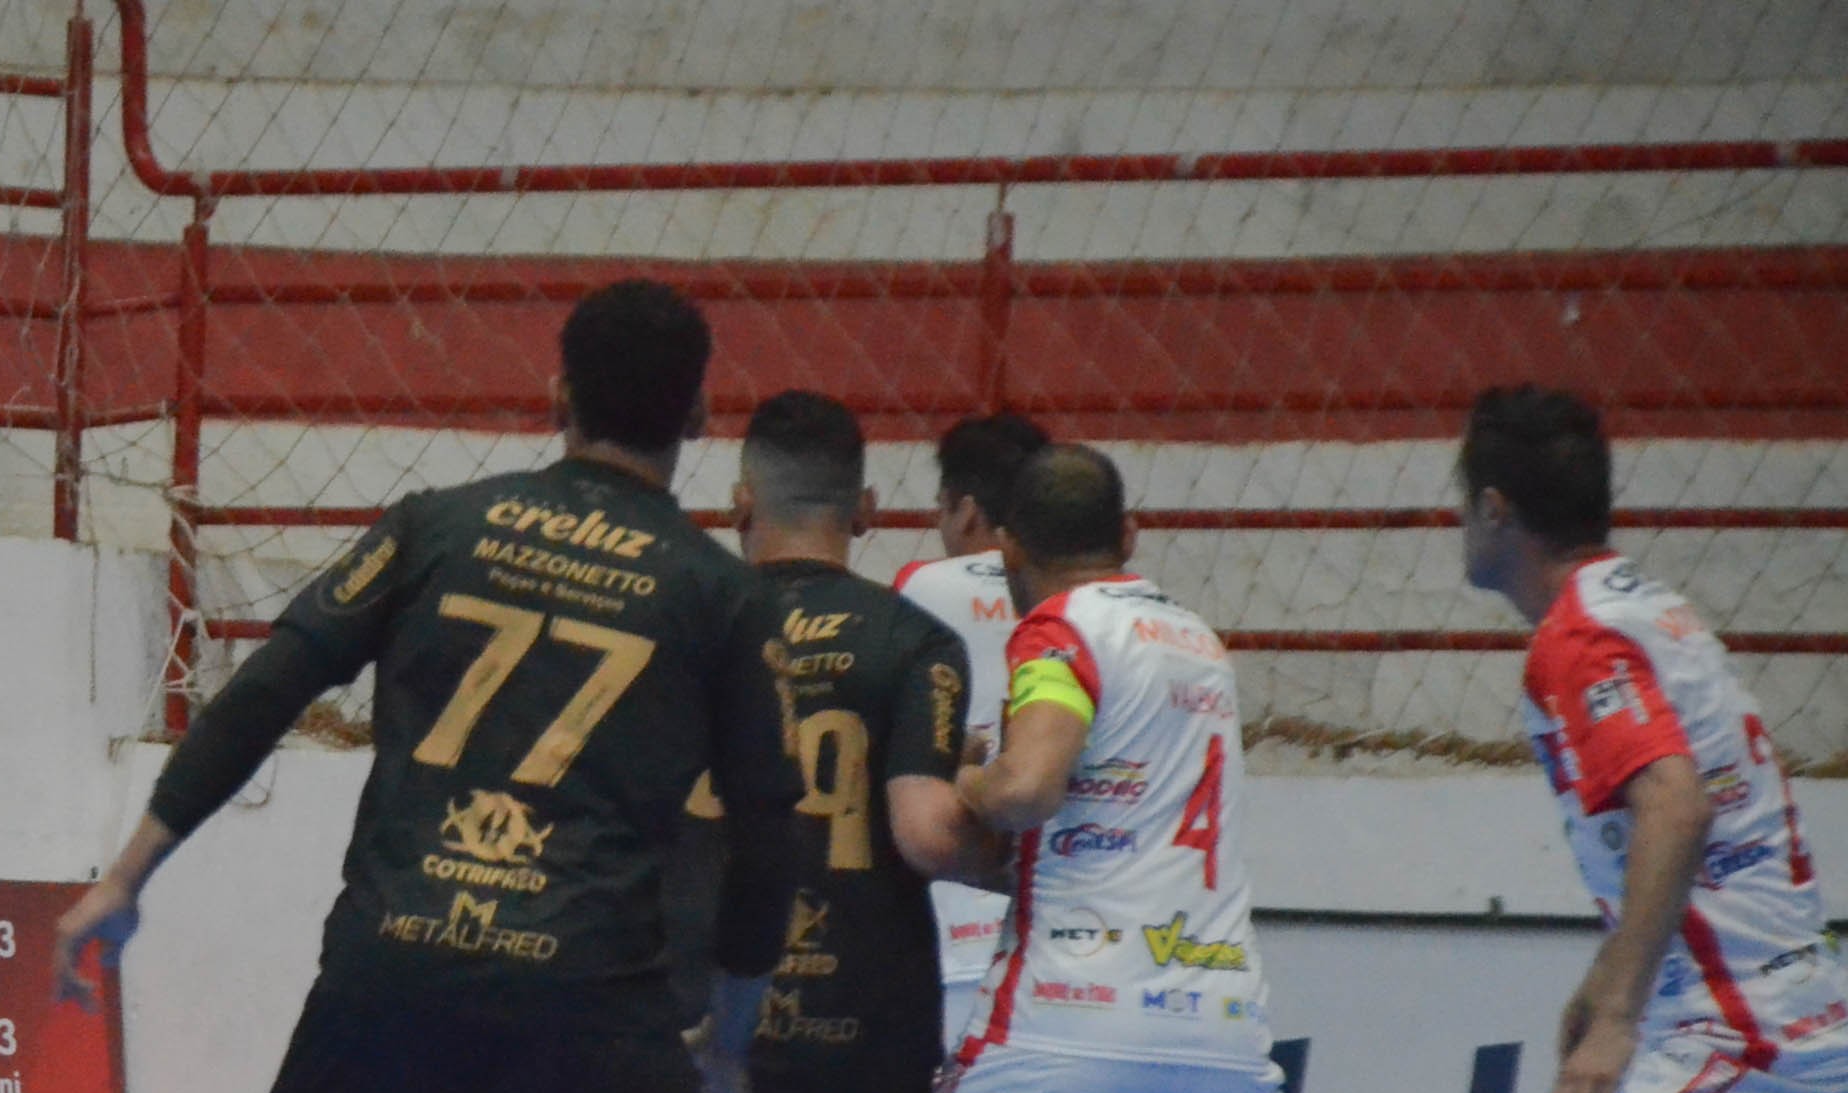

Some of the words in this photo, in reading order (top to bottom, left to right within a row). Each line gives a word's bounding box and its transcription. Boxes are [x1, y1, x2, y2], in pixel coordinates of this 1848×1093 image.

[485, 500, 656, 559] creluz
[473, 537, 657, 596] MAZZONETTO
[412, 593, 657, 788] 77
[1171, 733, 1226, 892] 4
[378, 912, 558, 961] METALFRED
